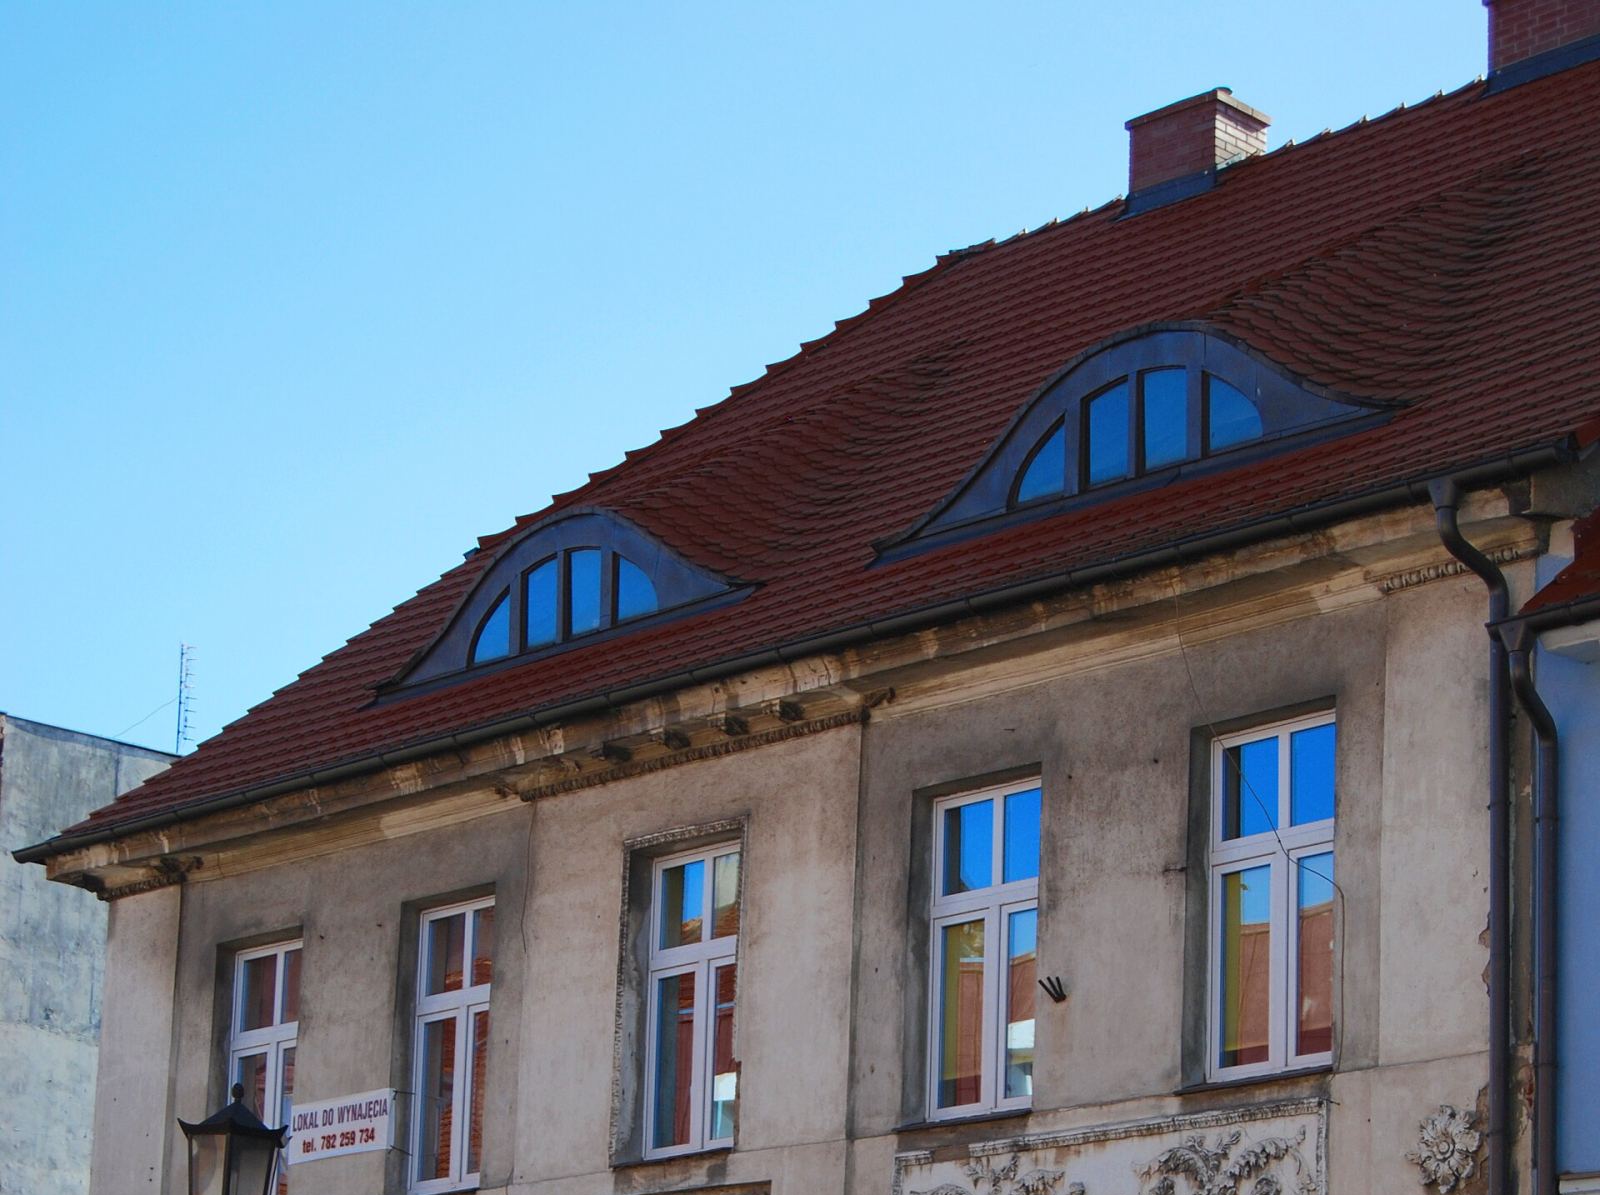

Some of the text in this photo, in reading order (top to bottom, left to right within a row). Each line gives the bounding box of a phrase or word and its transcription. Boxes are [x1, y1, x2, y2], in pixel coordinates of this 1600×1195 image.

[292, 1098, 388, 1132] LOKAL DO WYNAJĘCIA
[302, 1127, 375, 1153] tel. 782 259 734
